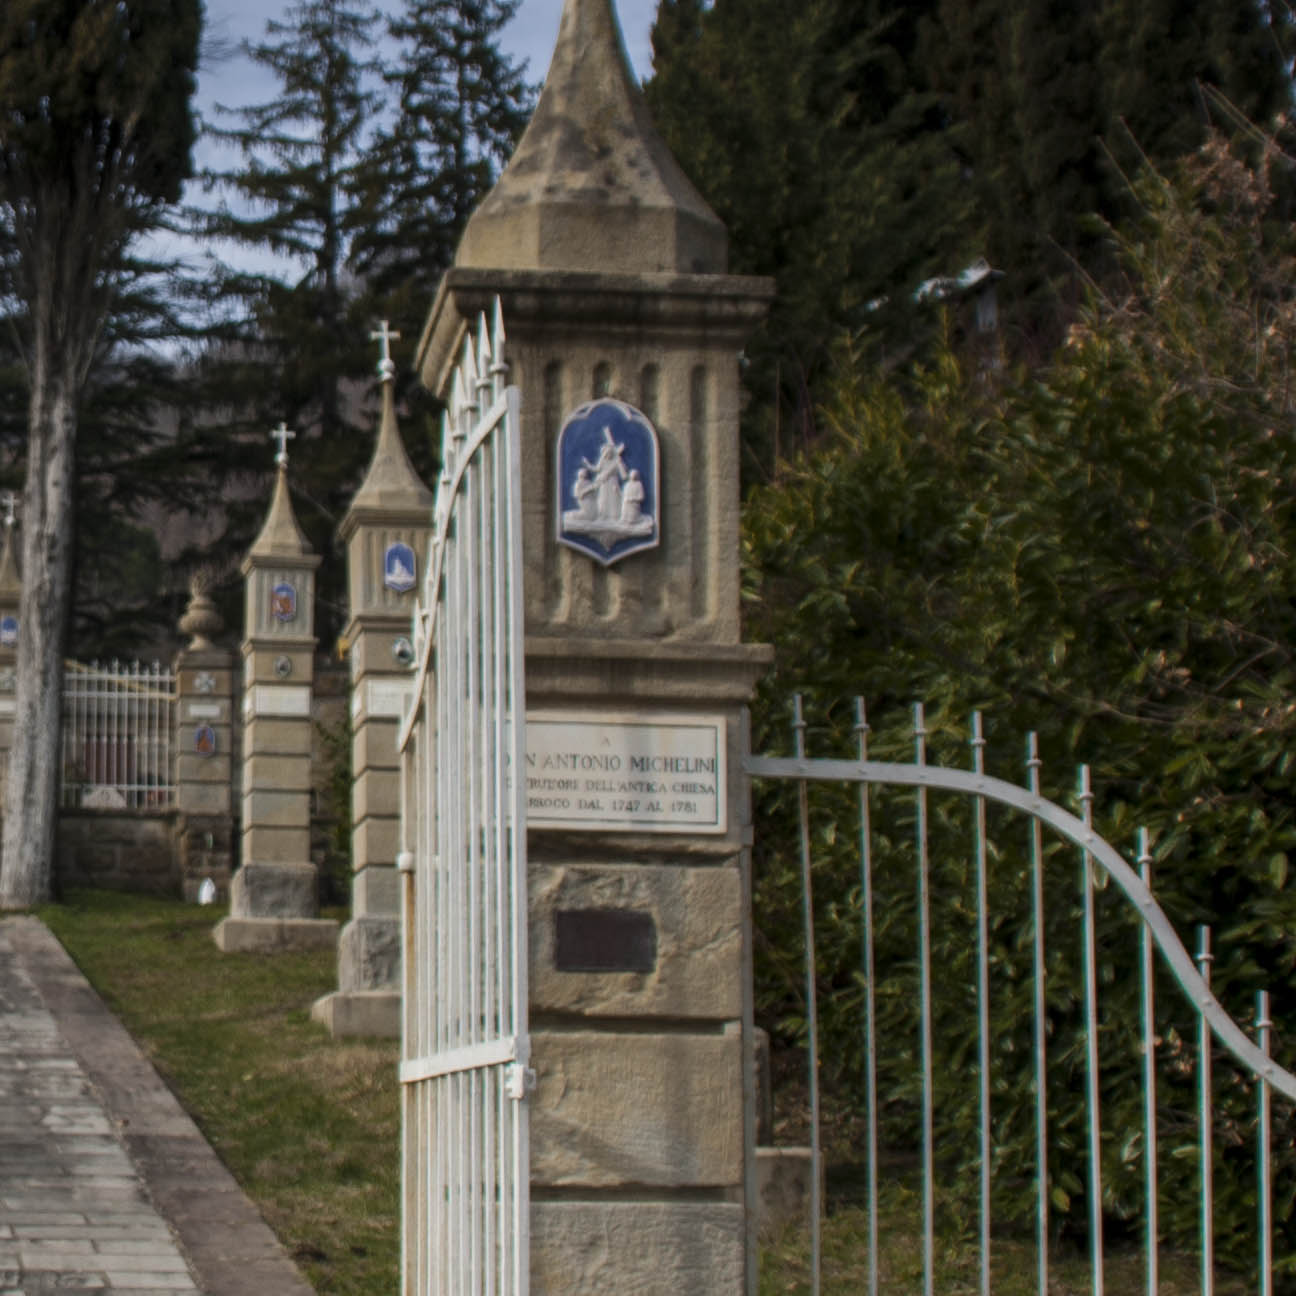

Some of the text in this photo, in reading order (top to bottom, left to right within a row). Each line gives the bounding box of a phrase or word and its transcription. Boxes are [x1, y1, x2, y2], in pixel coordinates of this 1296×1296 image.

[542, 753, 622, 772] ANTONIO
[629, 755, 716, 774] MICHELINI
[672, 781, 716, 796] CHIESA
